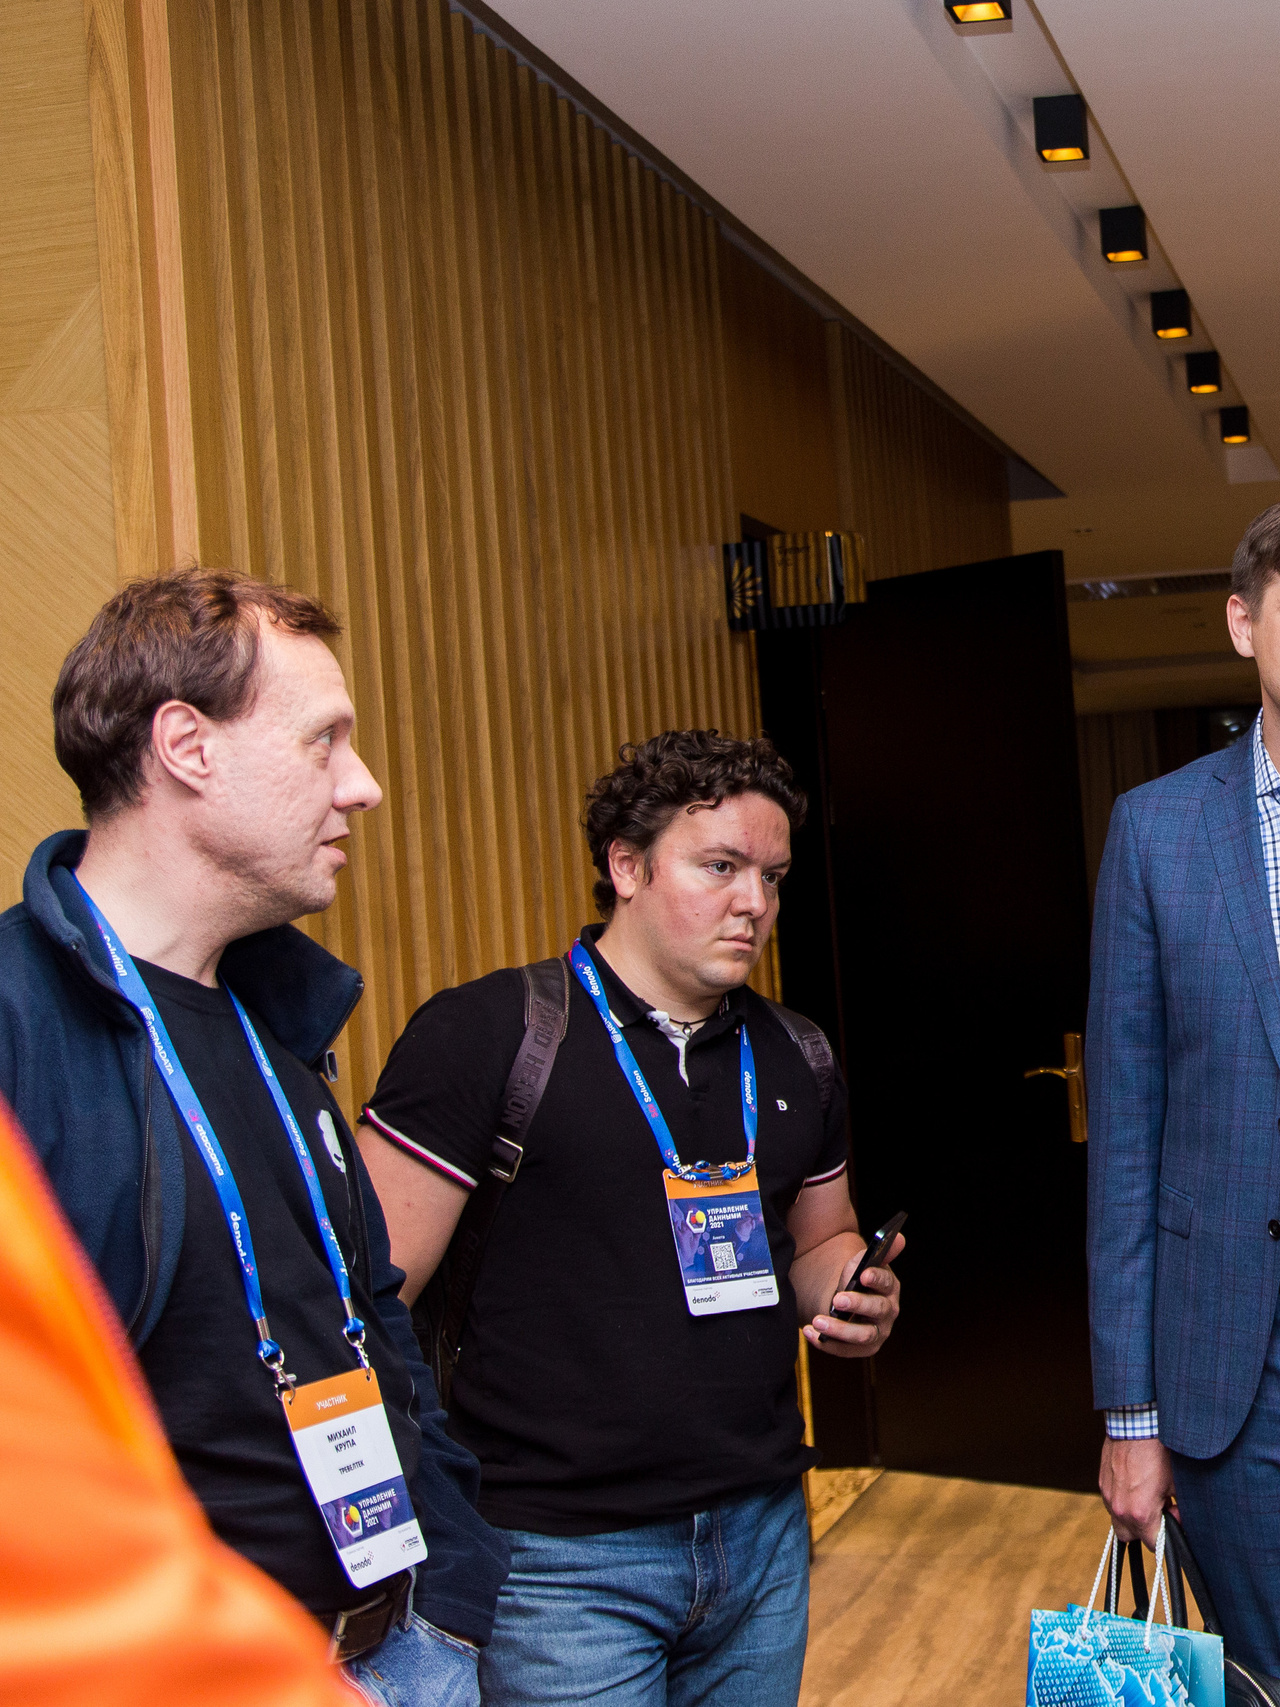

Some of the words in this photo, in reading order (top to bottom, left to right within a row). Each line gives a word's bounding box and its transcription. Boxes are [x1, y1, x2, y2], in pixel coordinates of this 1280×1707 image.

[583, 965, 601, 997] denodo
[633, 1070, 652, 1103] Solution
[744, 1071, 753, 1105] denodo
[286, 1114, 308, 1157] Solution
[196, 1124, 225, 1177] ataccama
[706, 1204, 749, 1215] УПРАВЛЕНИЕ
[708, 1212, 742, 1223] ДАННЫМИ
[710, 1221, 725, 1229] 2021
[692, 1294, 717, 1305] denodo
[316, 1393, 348, 1411] УЧАСТНИК
[327, 1425, 357, 1443] МИХАИЛ
[334, 1438, 357, 1454] КРУПА
[338, 1459, 365, 1475] ТРЕВЕЛТЕК
[358, 1488, 397, 1509] УПРАВЛЕНИЕ
[362, 1500, 393, 1519] ДАННЫМИ
[366, 1516, 379, 1528] 2021
[350, 1557, 372, 1573] denodo
